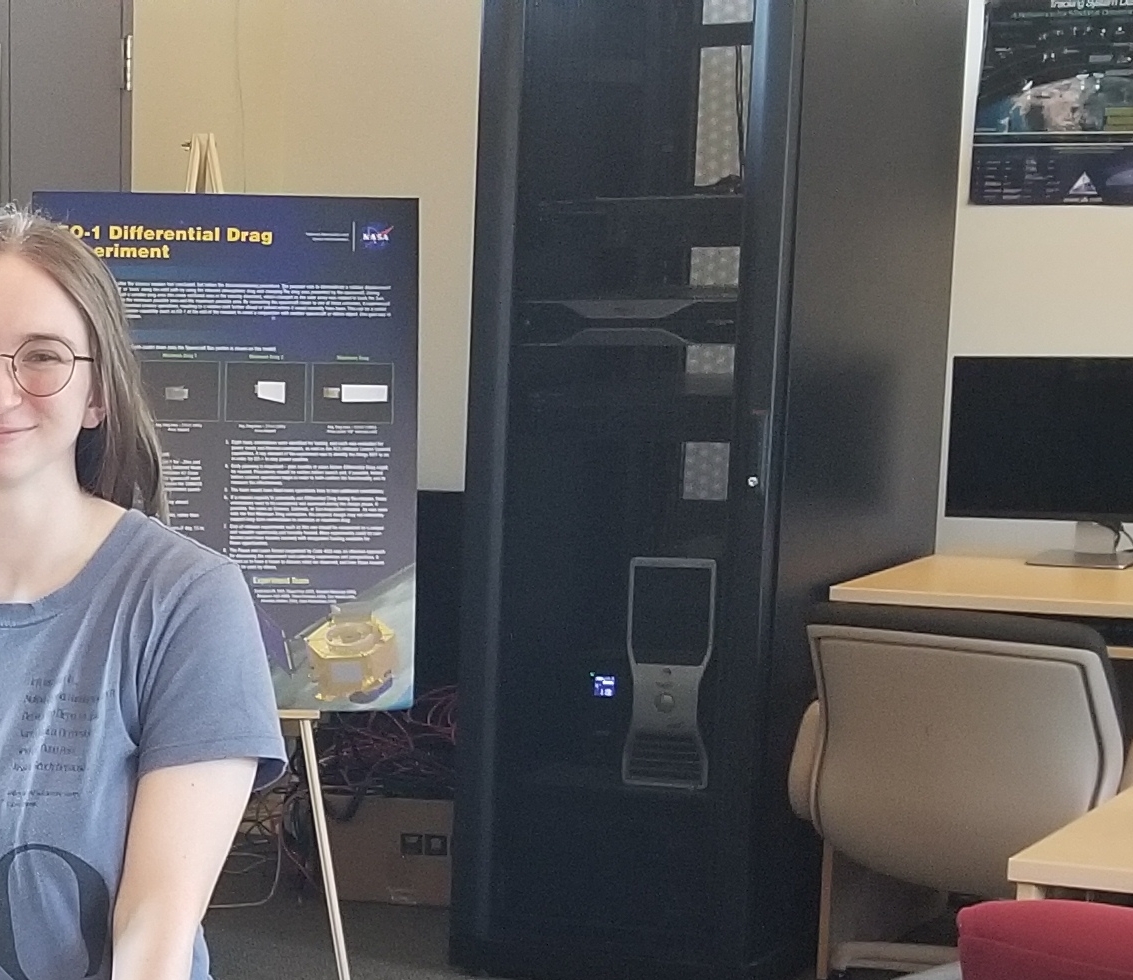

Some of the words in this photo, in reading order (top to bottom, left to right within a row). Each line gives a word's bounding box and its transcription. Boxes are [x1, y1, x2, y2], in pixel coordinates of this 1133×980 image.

[109, 226, 220, 241] Differential
[226, 227, 273, 245] Drag
[362, 233, 389, 241] NASA
[93, 243, 170, 258] eriment
